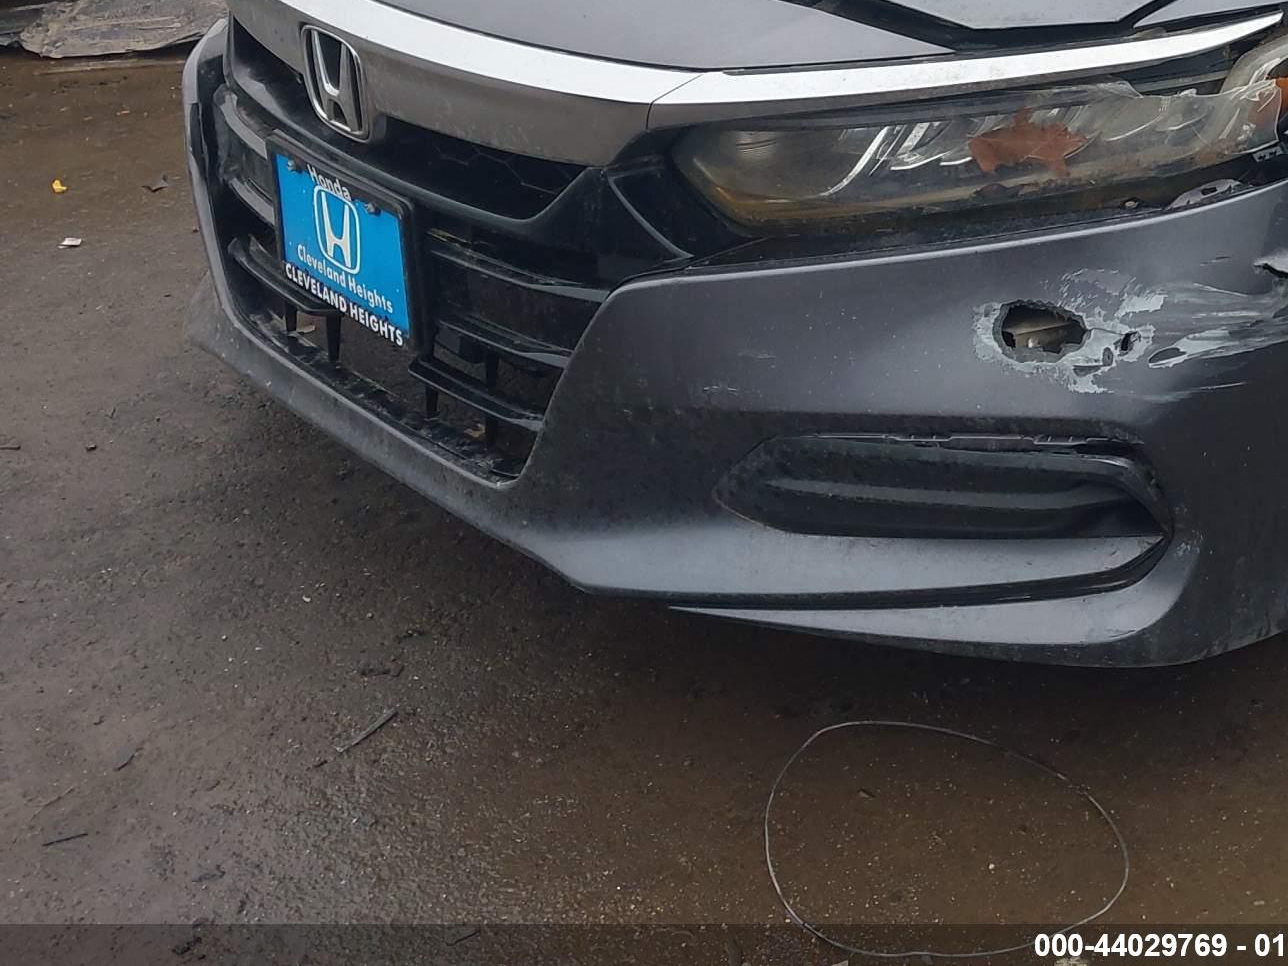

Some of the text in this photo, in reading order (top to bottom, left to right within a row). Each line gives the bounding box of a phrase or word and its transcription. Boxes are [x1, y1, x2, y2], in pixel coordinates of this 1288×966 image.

[307, 163, 352, 203] Honda
[284, 262, 404, 348] CLEVELAND HEIGHTS
[297, 243, 394, 315] Cleveland Heights
